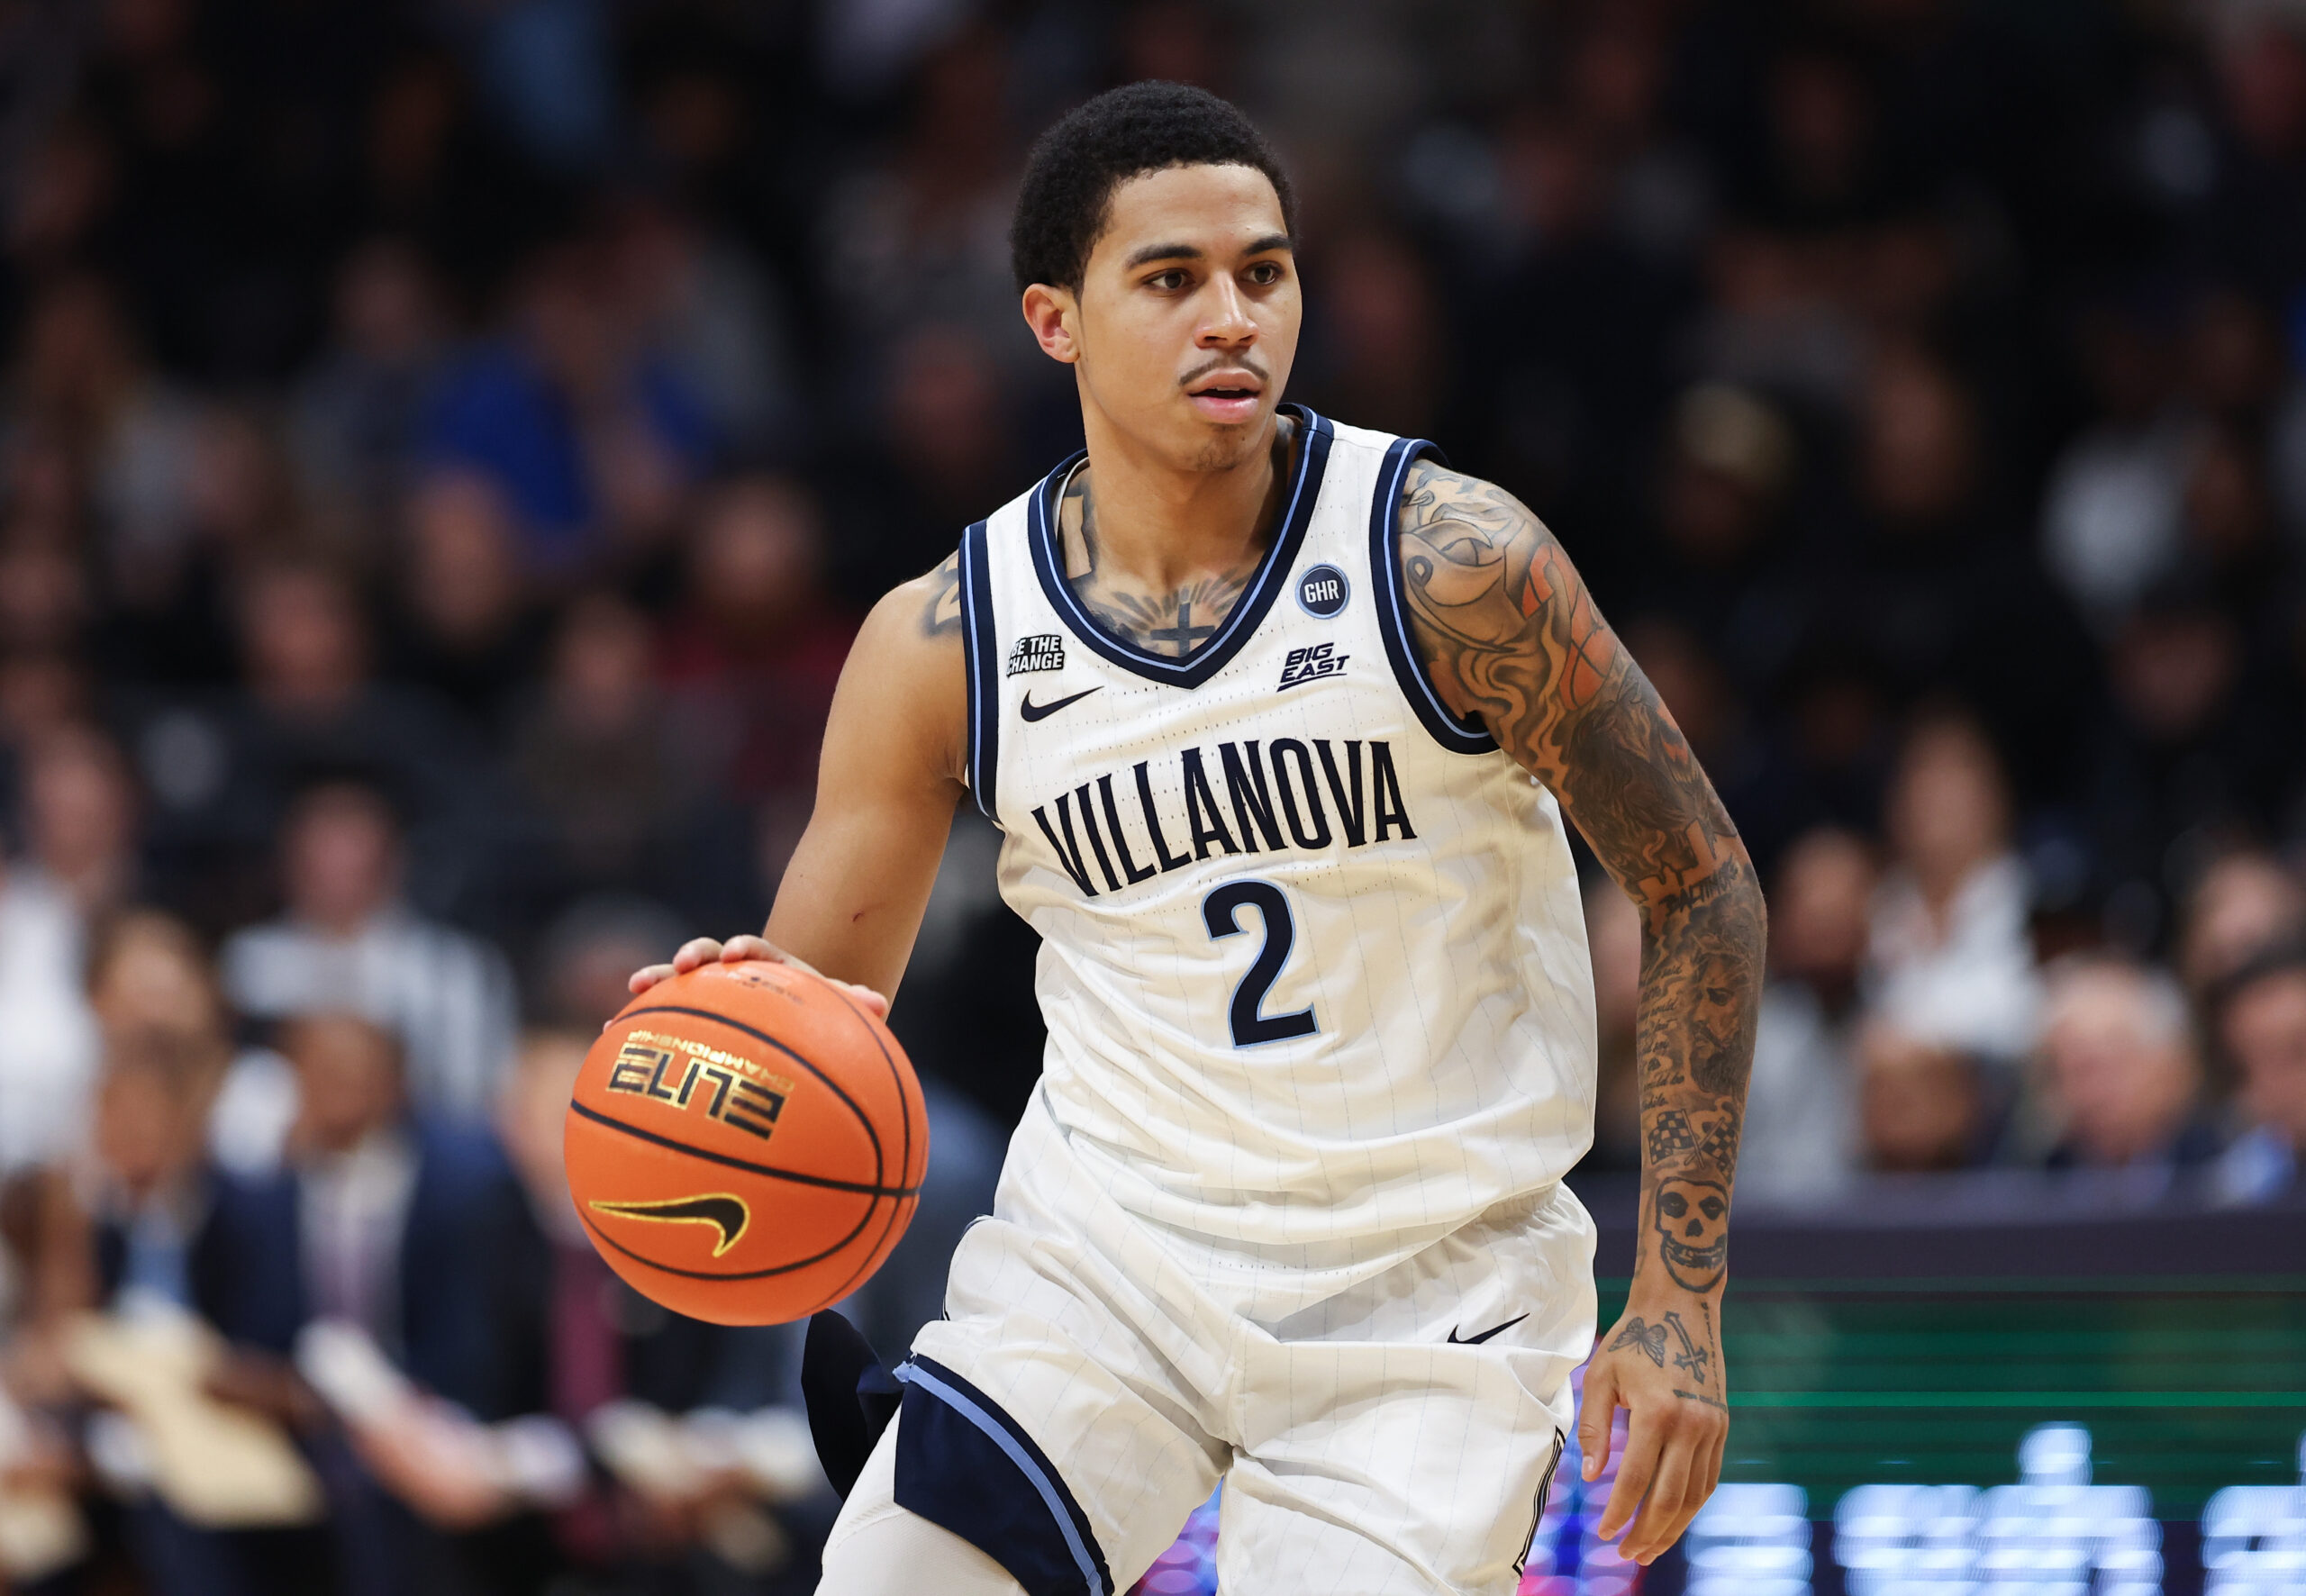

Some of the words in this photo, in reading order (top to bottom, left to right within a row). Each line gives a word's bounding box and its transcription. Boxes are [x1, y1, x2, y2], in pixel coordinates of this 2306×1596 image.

[1304, 579, 1339, 603] GHR
[1030, 636, 1060, 653] THE
[1285, 642, 1334, 667] BIG
[1007, 652, 1064, 676] CHANGE
[1280, 655, 1349, 684] EAST
[1031, 738, 1417, 897] VILLANOVA
[1201, 878, 1321, 1050] 2
[628, 1029, 795, 1092] CHAMPIONSHIP
[606, 1042, 791, 1141] ELITE
